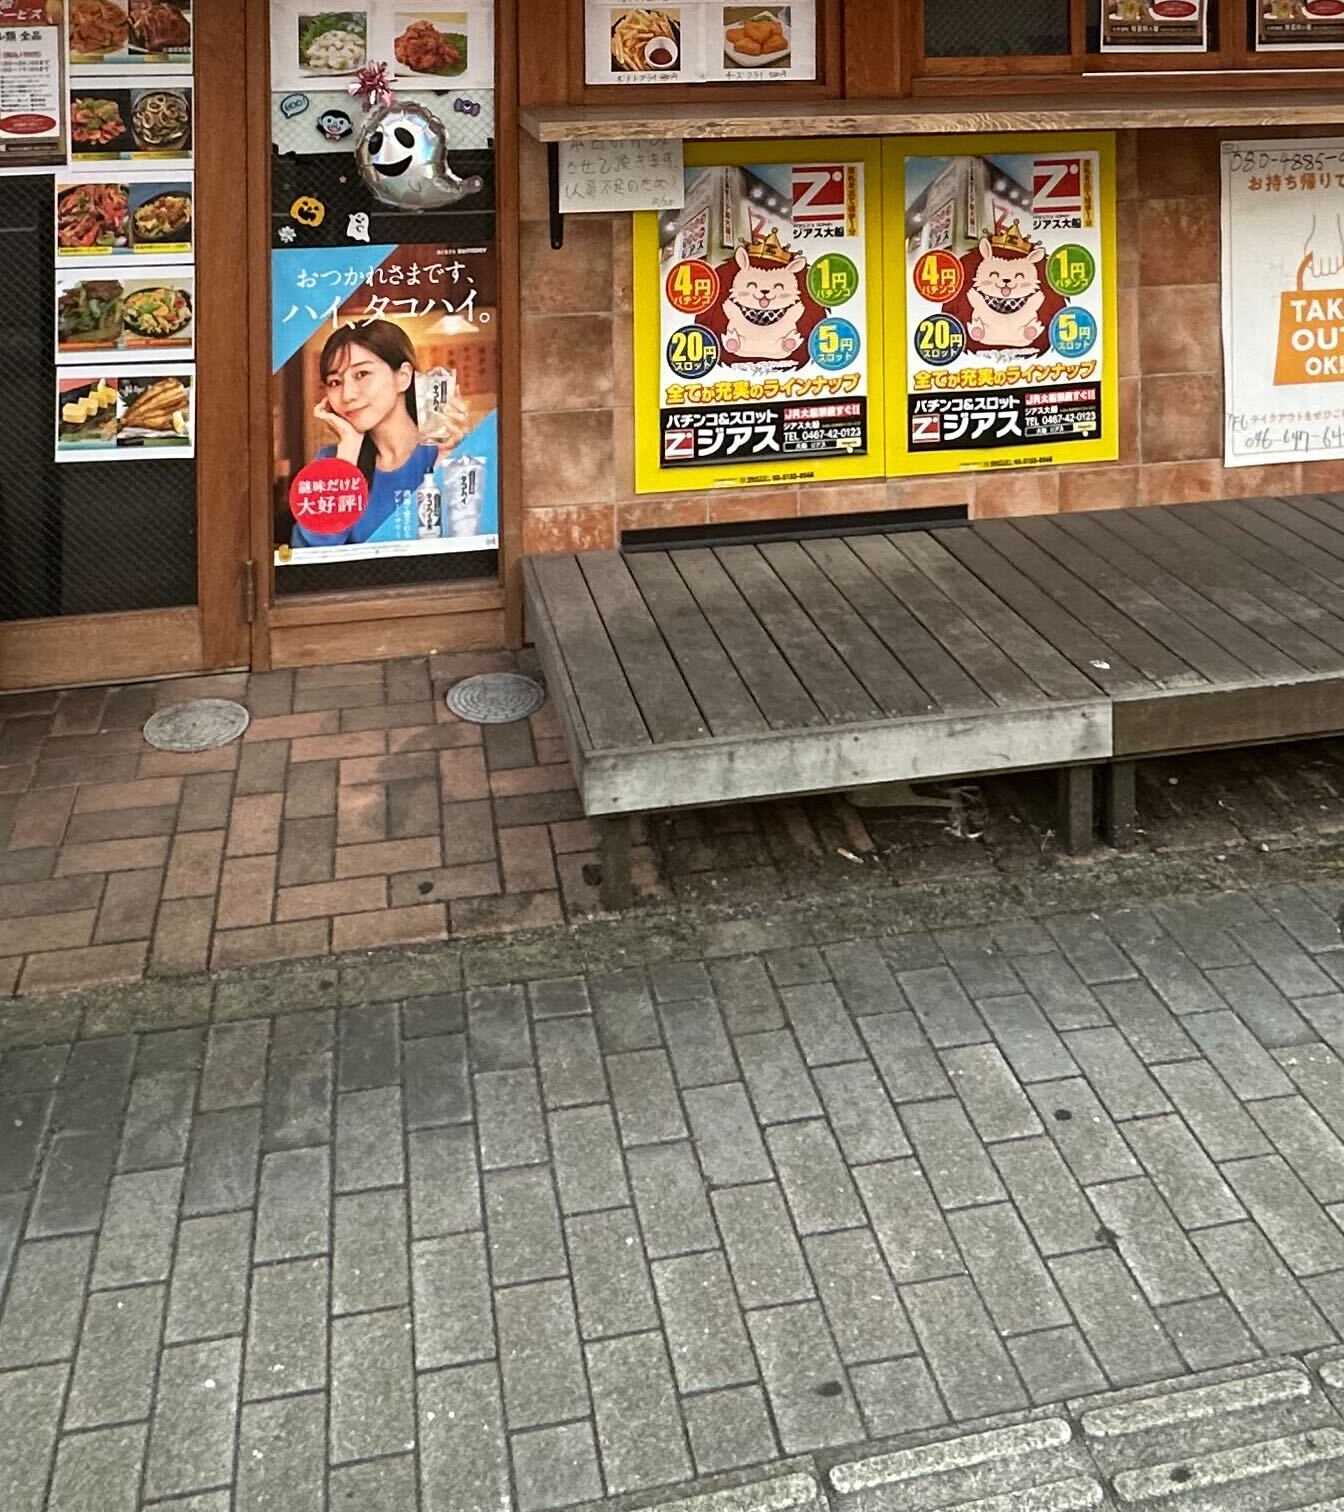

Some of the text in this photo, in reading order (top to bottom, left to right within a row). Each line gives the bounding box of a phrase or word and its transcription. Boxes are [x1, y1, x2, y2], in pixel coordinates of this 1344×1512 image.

[297, 260, 474, 288] おつかれさまです、
[816, 259, 846, 288] 1円
[921, 256, 956, 286] 4円
[1055, 251, 1085, 279] 1円
[674, 265, 710, 297] 4円
[921, 283, 955, 294] パチンコ
[1055, 277, 1088, 287] パチンコ
[672, 296, 710, 307] パチンコ
[816, 288, 851, 299] パチンコ
[282, 289, 490, 330] ハイ、タコハイ。
[818, 325, 853, 352] 5円
[919, 320, 962, 349] 20円
[1058, 314, 1090, 340] 5円
[671, 332, 716, 361] 20円
[818, 351, 852, 362] スロット
[922, 348, 956, 358] スロット
[1058, 339, 1091, 350] スロット
[673, 360, 712, 371] スロット
[913, 359, 1096, 390] 全てが充実のラインナップ
[1305, 356, 1344, 376] OK!
[665, 373, 860, 405] 全てが充実のラインナップ
[914, 397, 1020, 412] パチンコ&スロット
[666, 411, 779, 428] パチンコ&スロット
[943, 411, 1022, 440] ジアス
[1025, 417, 1039, 426] TEL
[696, 426, 780, 456] ジアス
[784, 432, 799, 441] TEL
[297, 494, 363, 516] 大好評!
